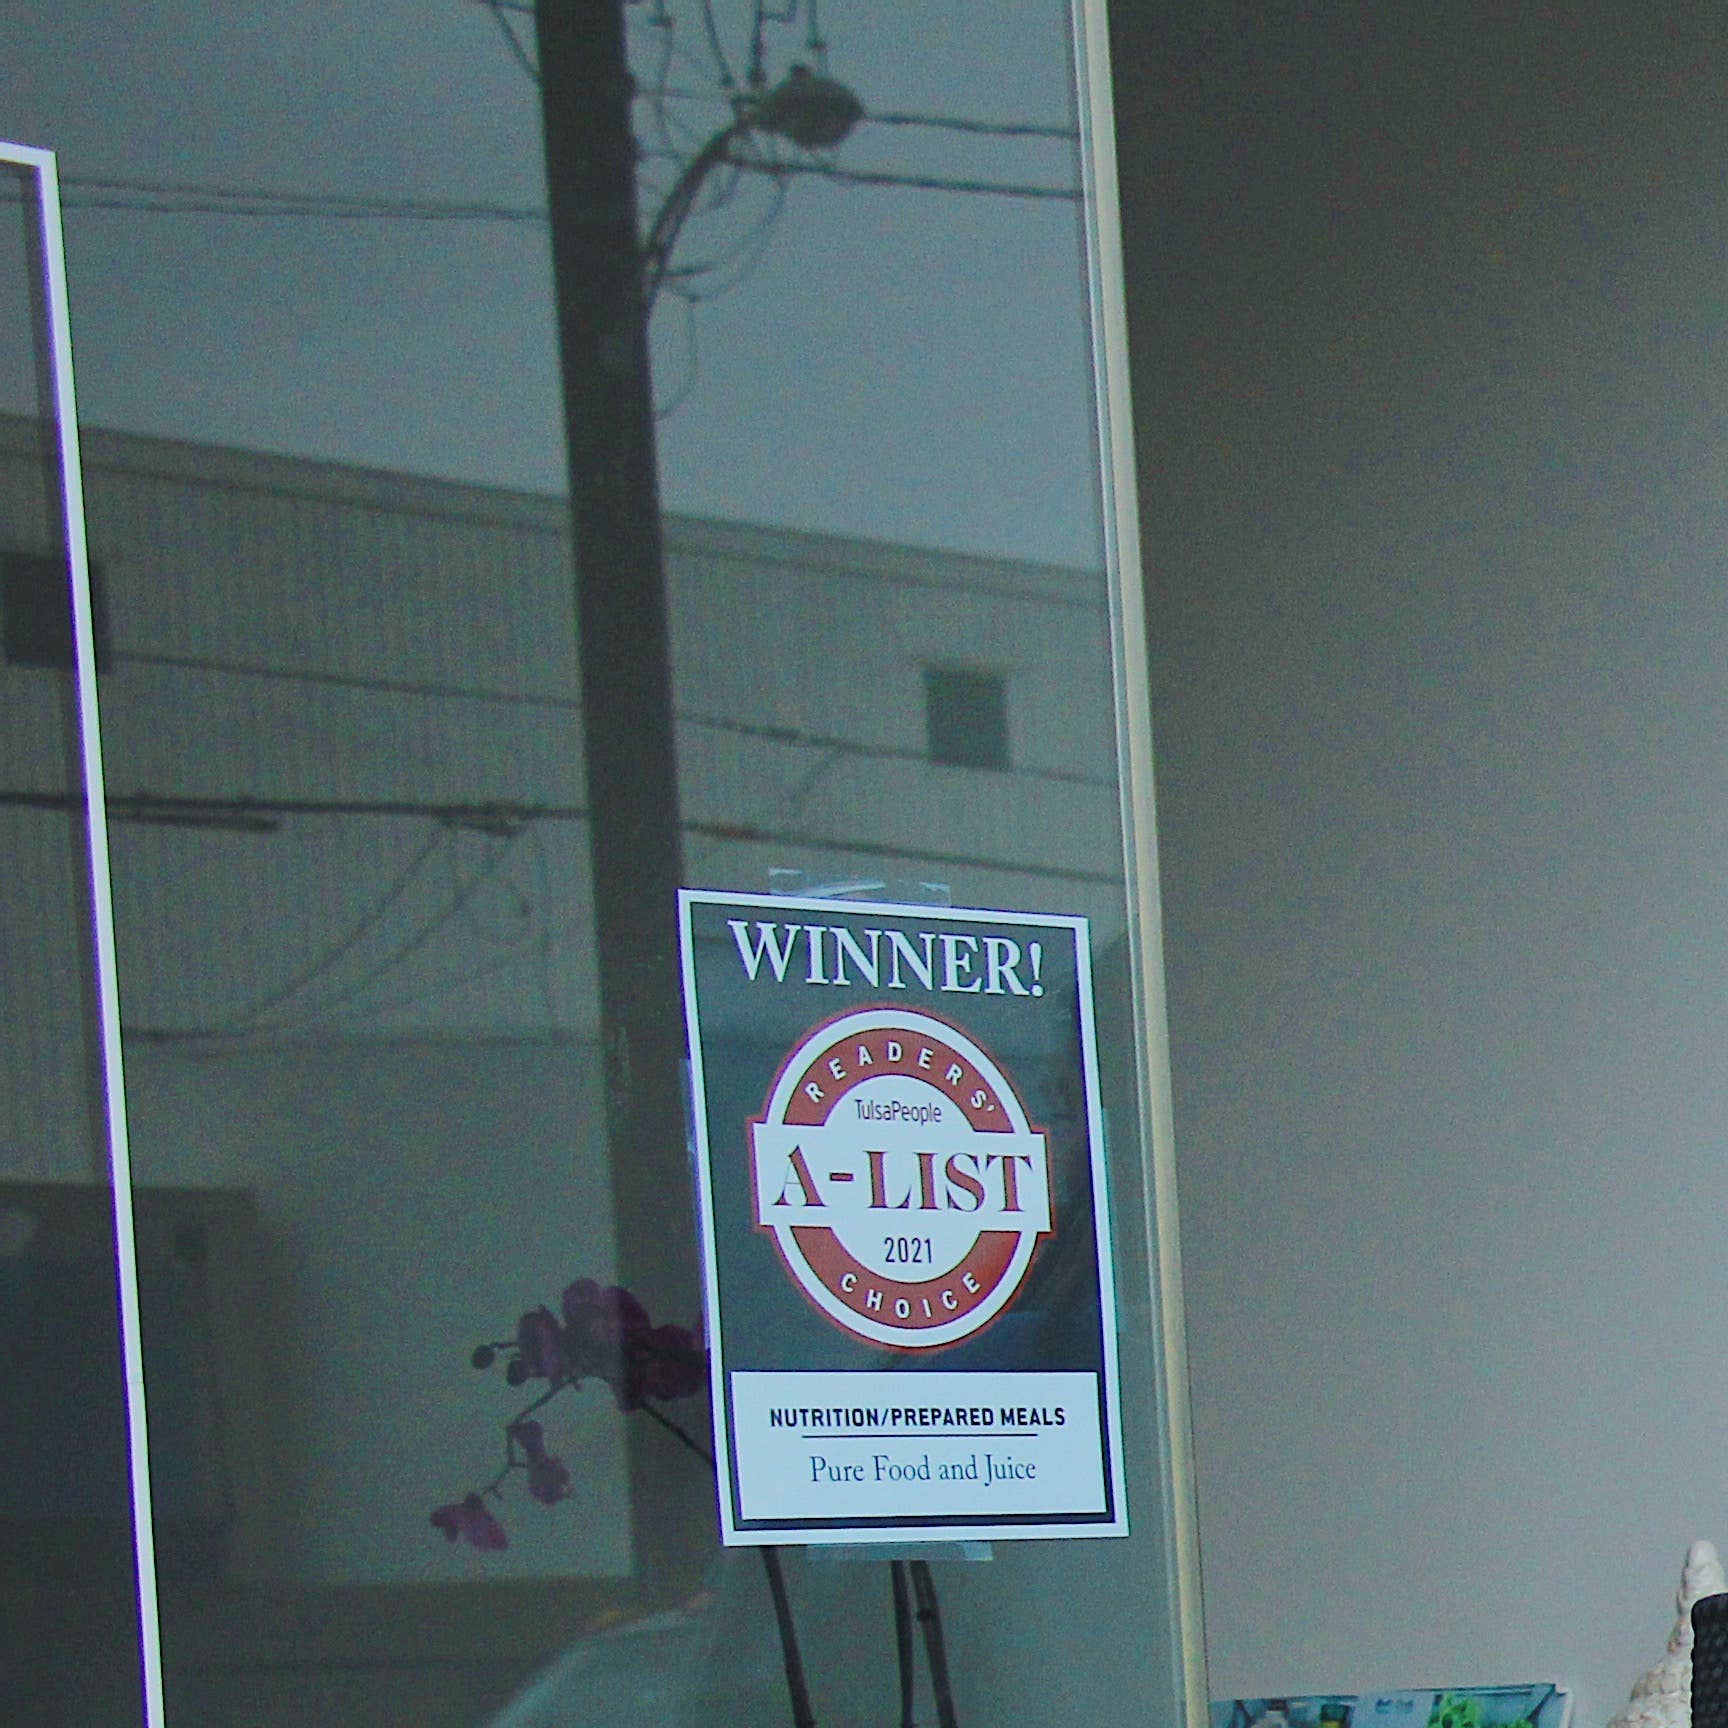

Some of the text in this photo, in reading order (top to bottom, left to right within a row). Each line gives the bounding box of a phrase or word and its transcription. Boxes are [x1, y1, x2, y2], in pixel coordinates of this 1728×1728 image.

[727, 919, 1044, 998] WINNER!
[804, 1041, 996, 1112] READERS'
[854, 1099, 943, 1127] TulsaPeople
[771, 1144, 1034, 1213] A-LIST
[884, 1237, 933, 1264] 2021
[839, 1272, 981, 1319] CHOICE
[769, 1406, 1066, 1428] NUTRITION/PREPARED MEALS
[809, 1453, 1037, 1487] Pure Food and Juice
